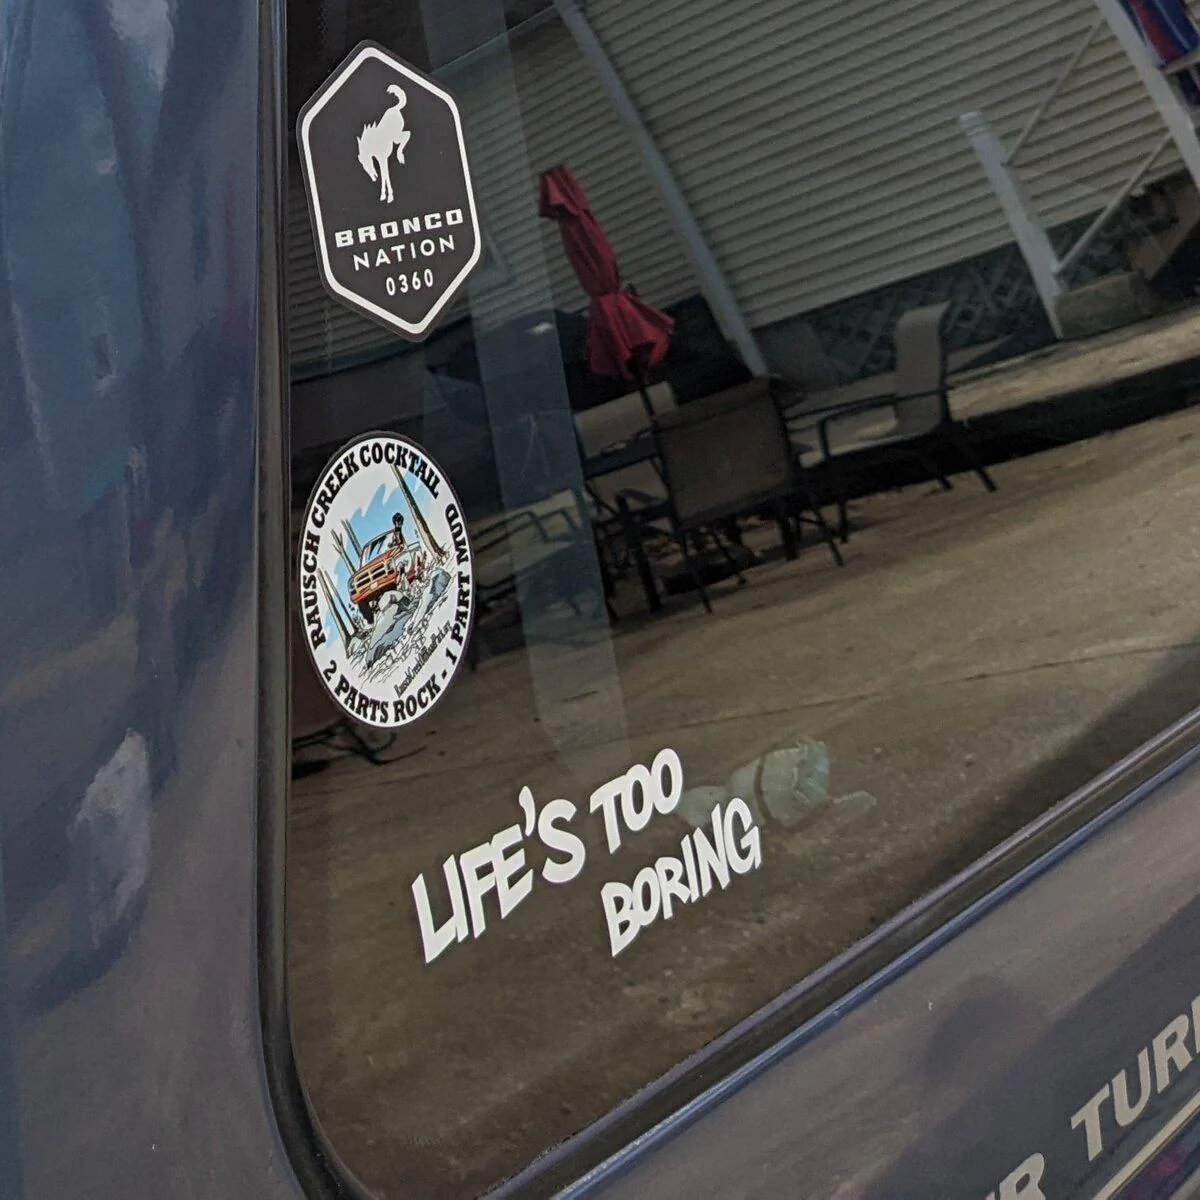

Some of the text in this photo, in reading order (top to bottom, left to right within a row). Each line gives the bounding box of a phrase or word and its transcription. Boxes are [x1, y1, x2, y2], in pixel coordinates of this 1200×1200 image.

[334, 208, 464, 248] BRONCO
[352, 234, 455, 271] NATION
[385, 267, 434, 297] 0360
[302, 442, 441, 650] RAUSCH CREEK COCKTAIL
[444, 502, 469, 566] MUD
[451, 571, 472, 647] PART
[323, 659, 337, 682] 2
[445, 647, 458, 666] 1
[333, 678, 390, 724] PARTS
[393, 673, 442, 724] ROCK
[589, 747, 684, 855] TOO
[411, 785, 587, 964] LIFE'S
[600, 797, 763, 958] BORING
[1070, 994, 1200, 1162] TUR
